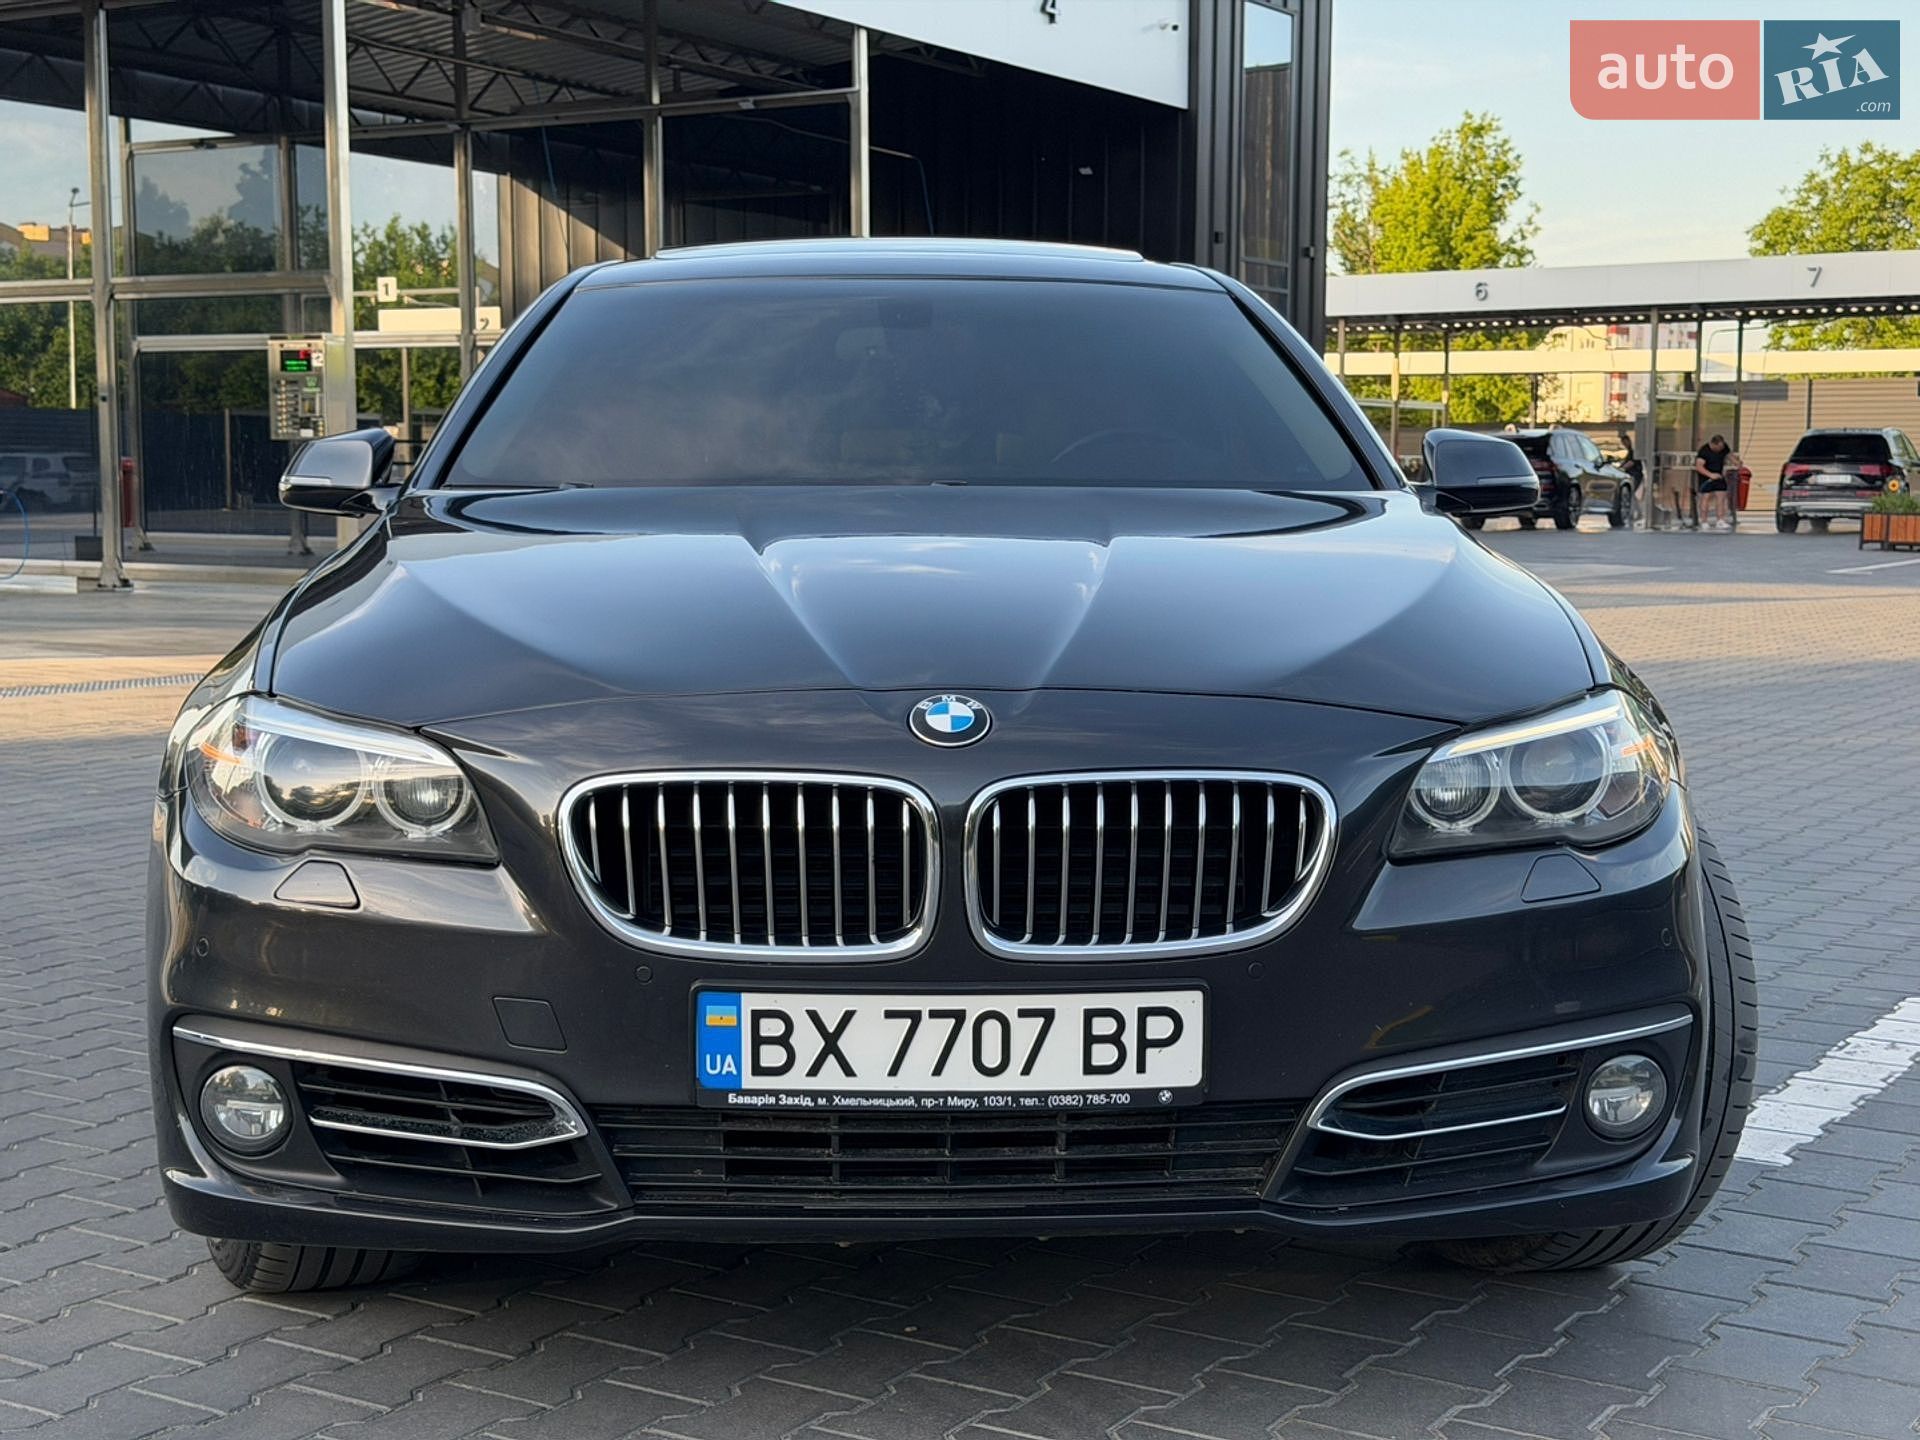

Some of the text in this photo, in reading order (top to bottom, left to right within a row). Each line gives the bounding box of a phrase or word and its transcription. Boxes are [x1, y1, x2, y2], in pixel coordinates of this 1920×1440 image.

[1807, 266, 1822, 288] 7
[382, 283, 390, 297] 1
[1475, 282, 1489, 302] 6
[916, 695, 984, 710] BMW
[749, 1006, 1185, 1078] BX 7707 BP
[705, 1054, 737, 1076] UA
[727, 1093, 1131, 1109] Баварія Захід, м. Хмельницький, пр-т Миру, 103/1, тел.: (0382) 785-700
